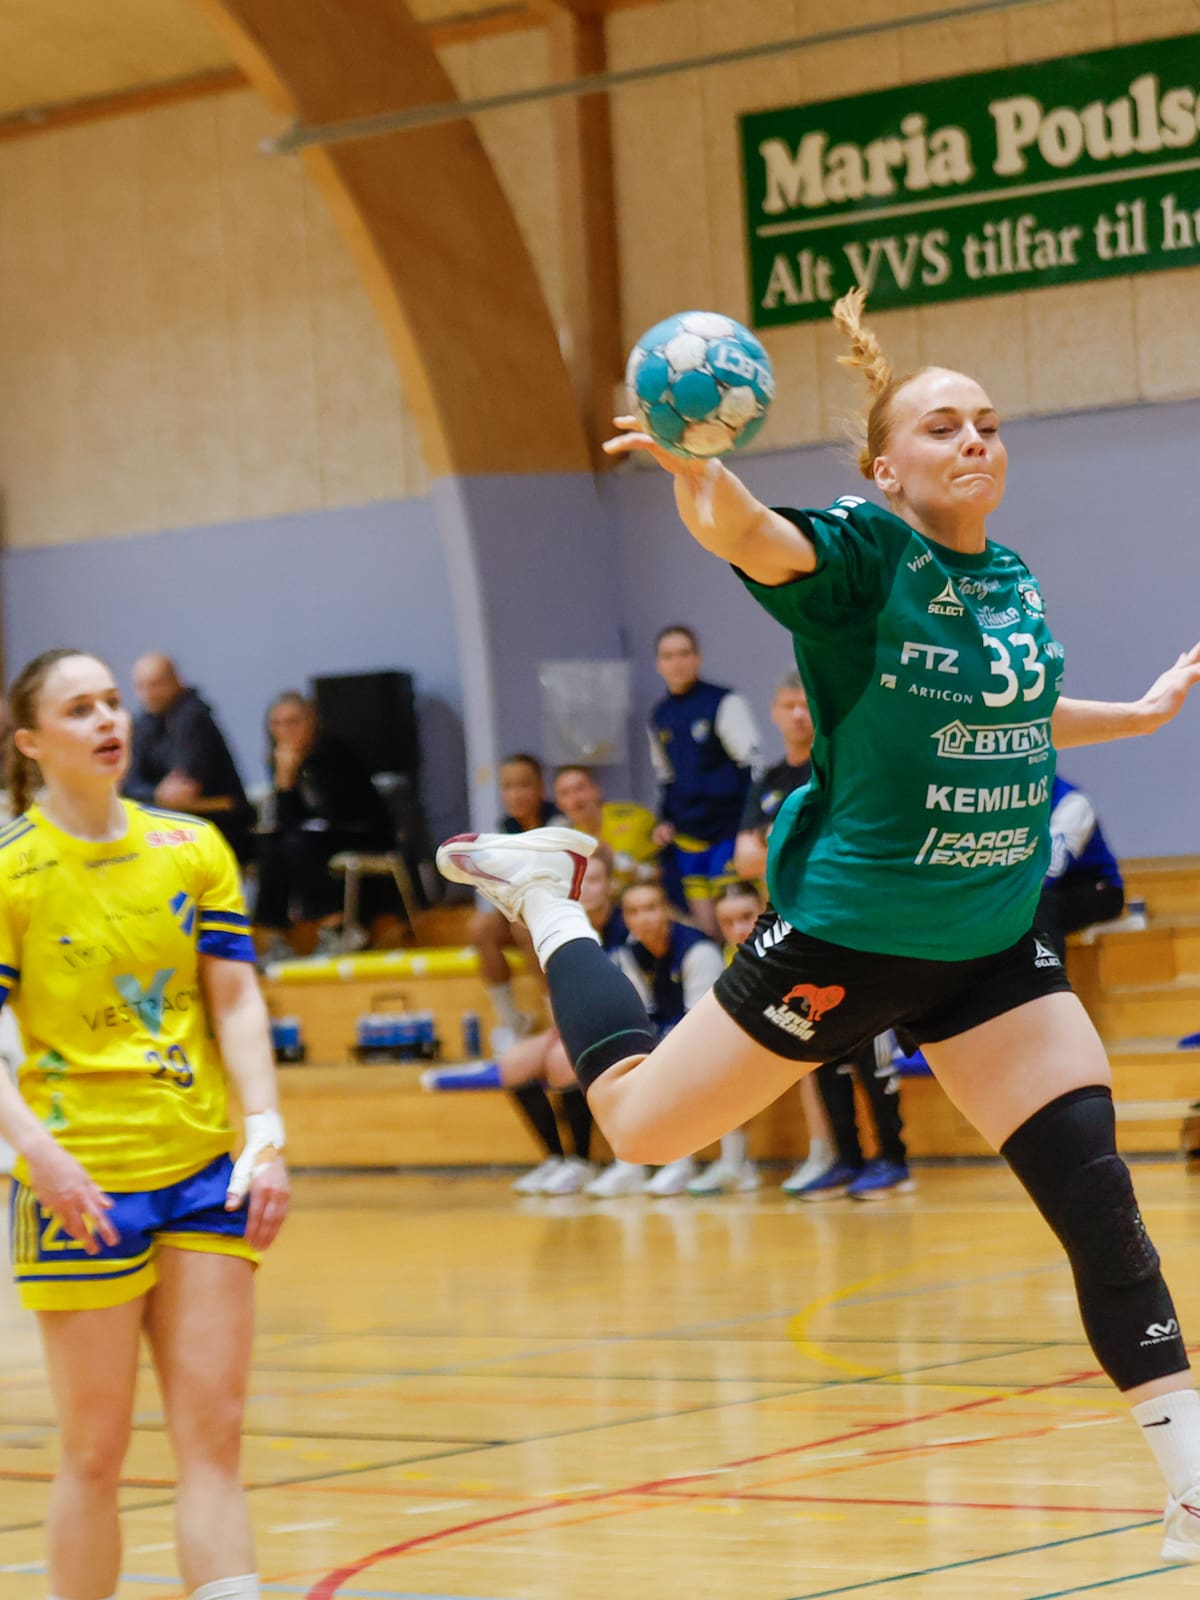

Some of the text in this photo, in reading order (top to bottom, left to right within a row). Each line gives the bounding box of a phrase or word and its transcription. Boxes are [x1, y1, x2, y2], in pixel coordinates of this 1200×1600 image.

[759, 113, 973, 215] Maria
[760, 253, 834, 309] Alt
[842, 228, 951, 291] VVS
[964, 212, 1082, 279] tilfar
[1094, 197, 1148, 259] til
[927, 603, 964, 617] SELECT
[900, 641, 959, 674] FTZ
[981, 632, 1046, 708] 33
[908, 683, 974, 705] ARTICON
[974, 723, 1048, 754] BYGM
[925, 775, 1049, 814] KEMILUX
[937, 826, 1030, 850] FAROE
